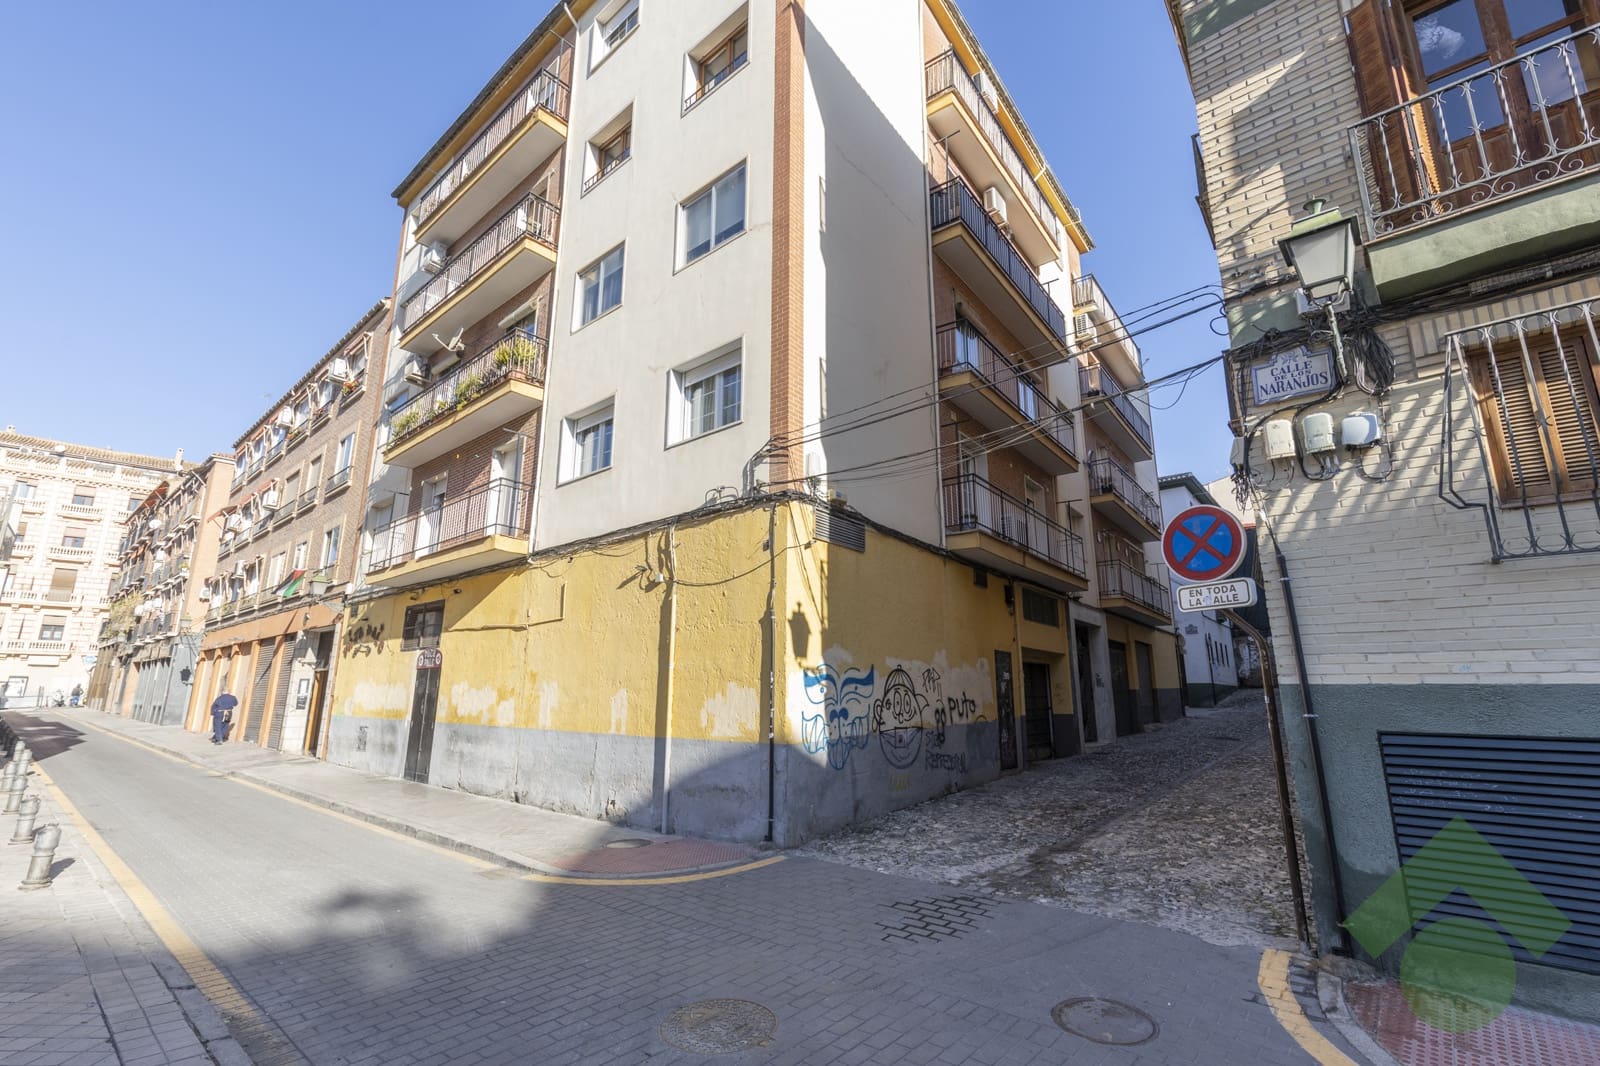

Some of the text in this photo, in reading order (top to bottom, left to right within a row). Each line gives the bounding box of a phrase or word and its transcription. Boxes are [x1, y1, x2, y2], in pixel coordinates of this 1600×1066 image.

[1270, 361, 1312, 376] CALLE
[1274, 369, 1311, 382] DE LOS
[1260, 371, 1328, 398] NARANJOS
[1189, 584, 1237, 598] EN TODA
[1189, 593, 1239, 607] LA ALLE
